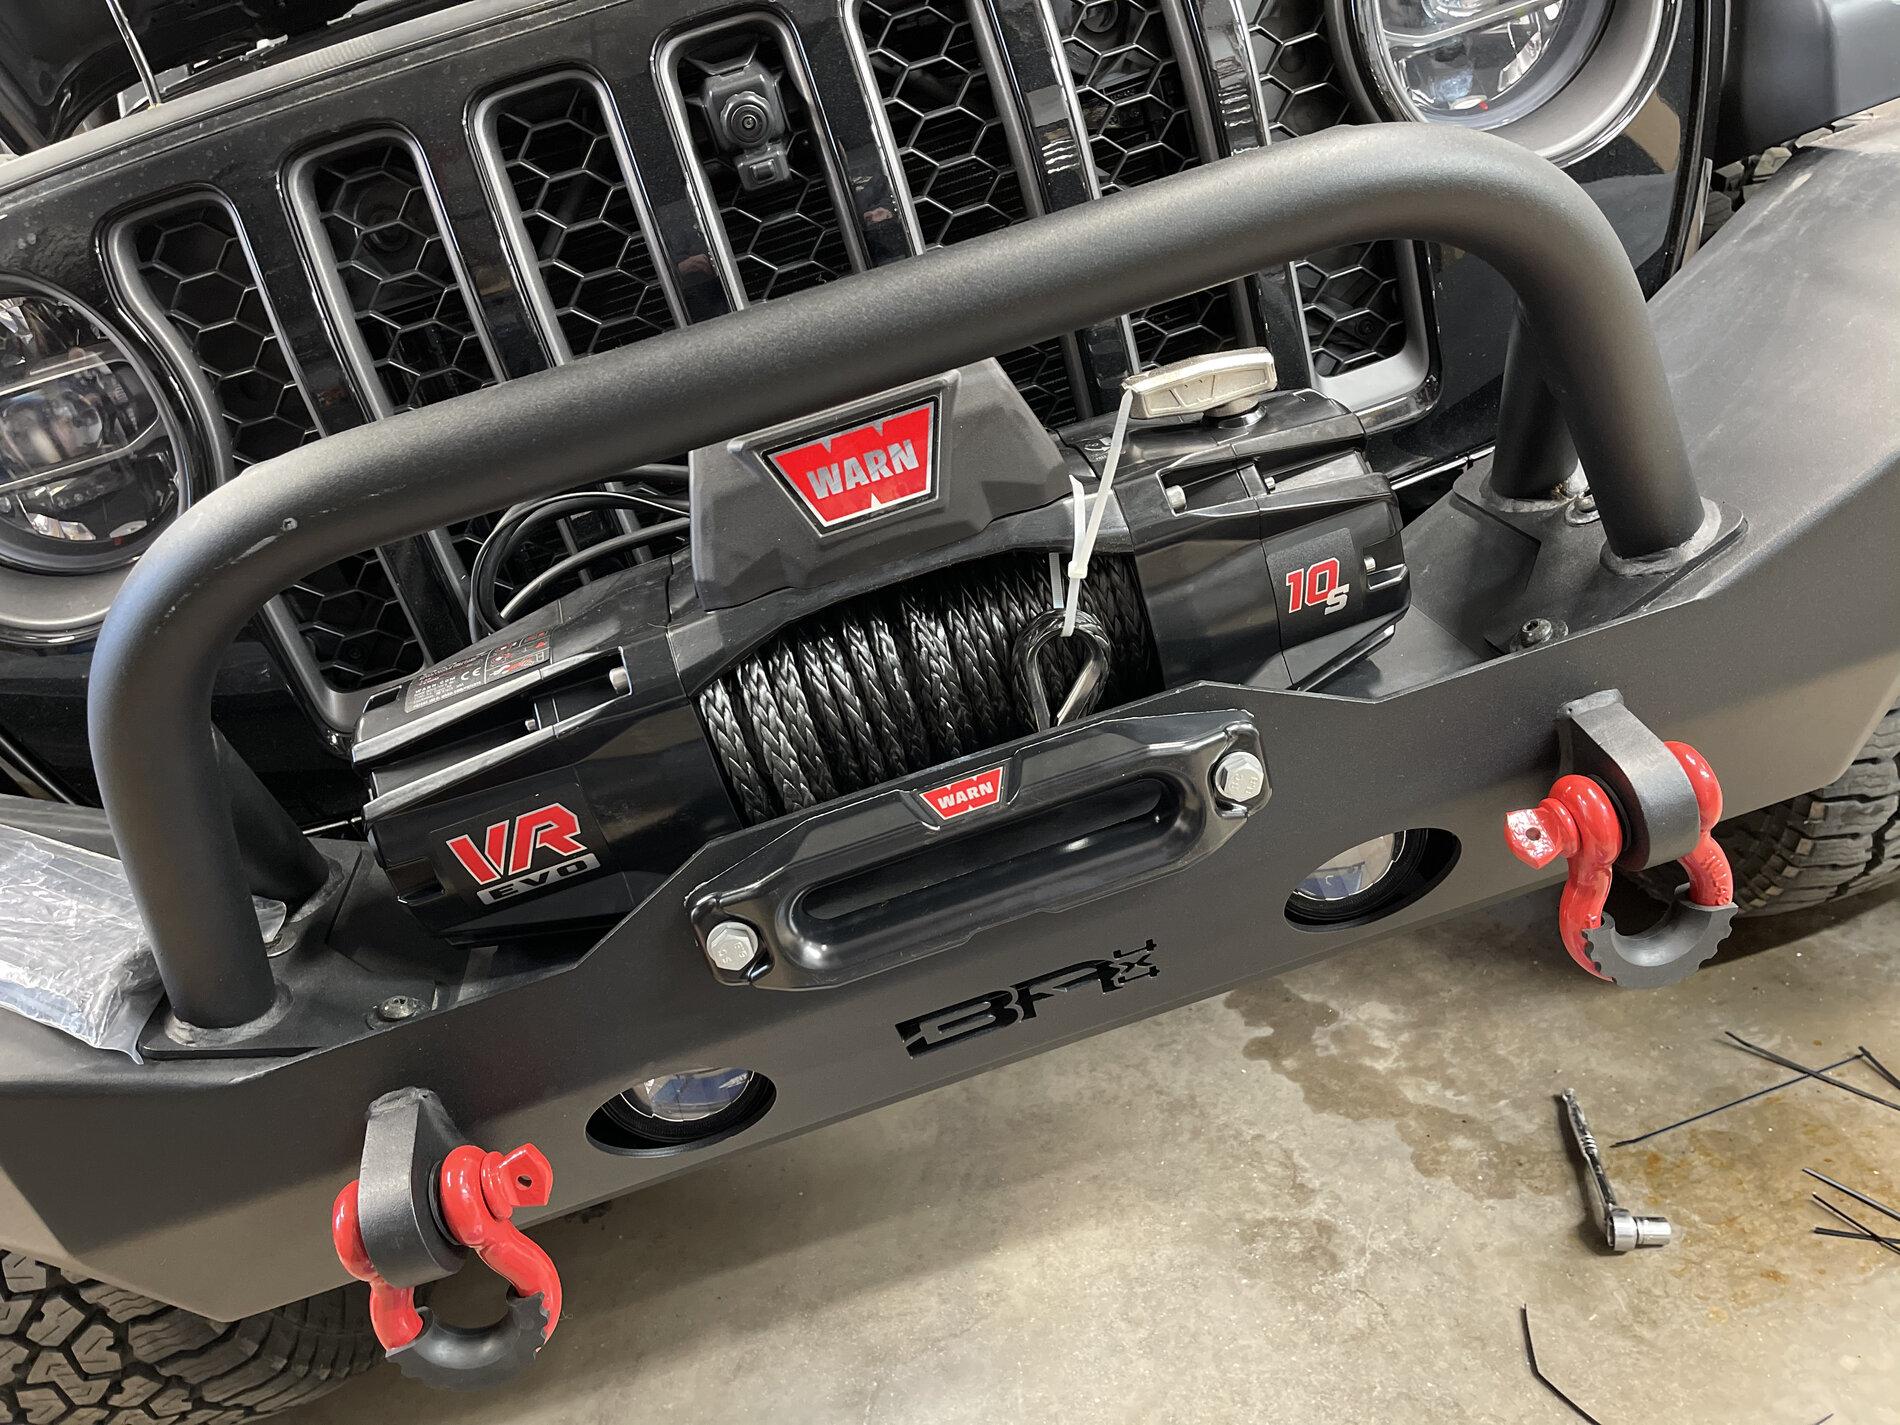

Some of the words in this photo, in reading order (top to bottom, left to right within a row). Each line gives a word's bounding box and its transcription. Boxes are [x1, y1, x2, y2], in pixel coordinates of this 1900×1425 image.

[806, 439, 919, 499] WARN
[937, 781, 994, 809] WARN
[446, 802, 588, 885] VR
[488, 860, 588, 900] EVO
